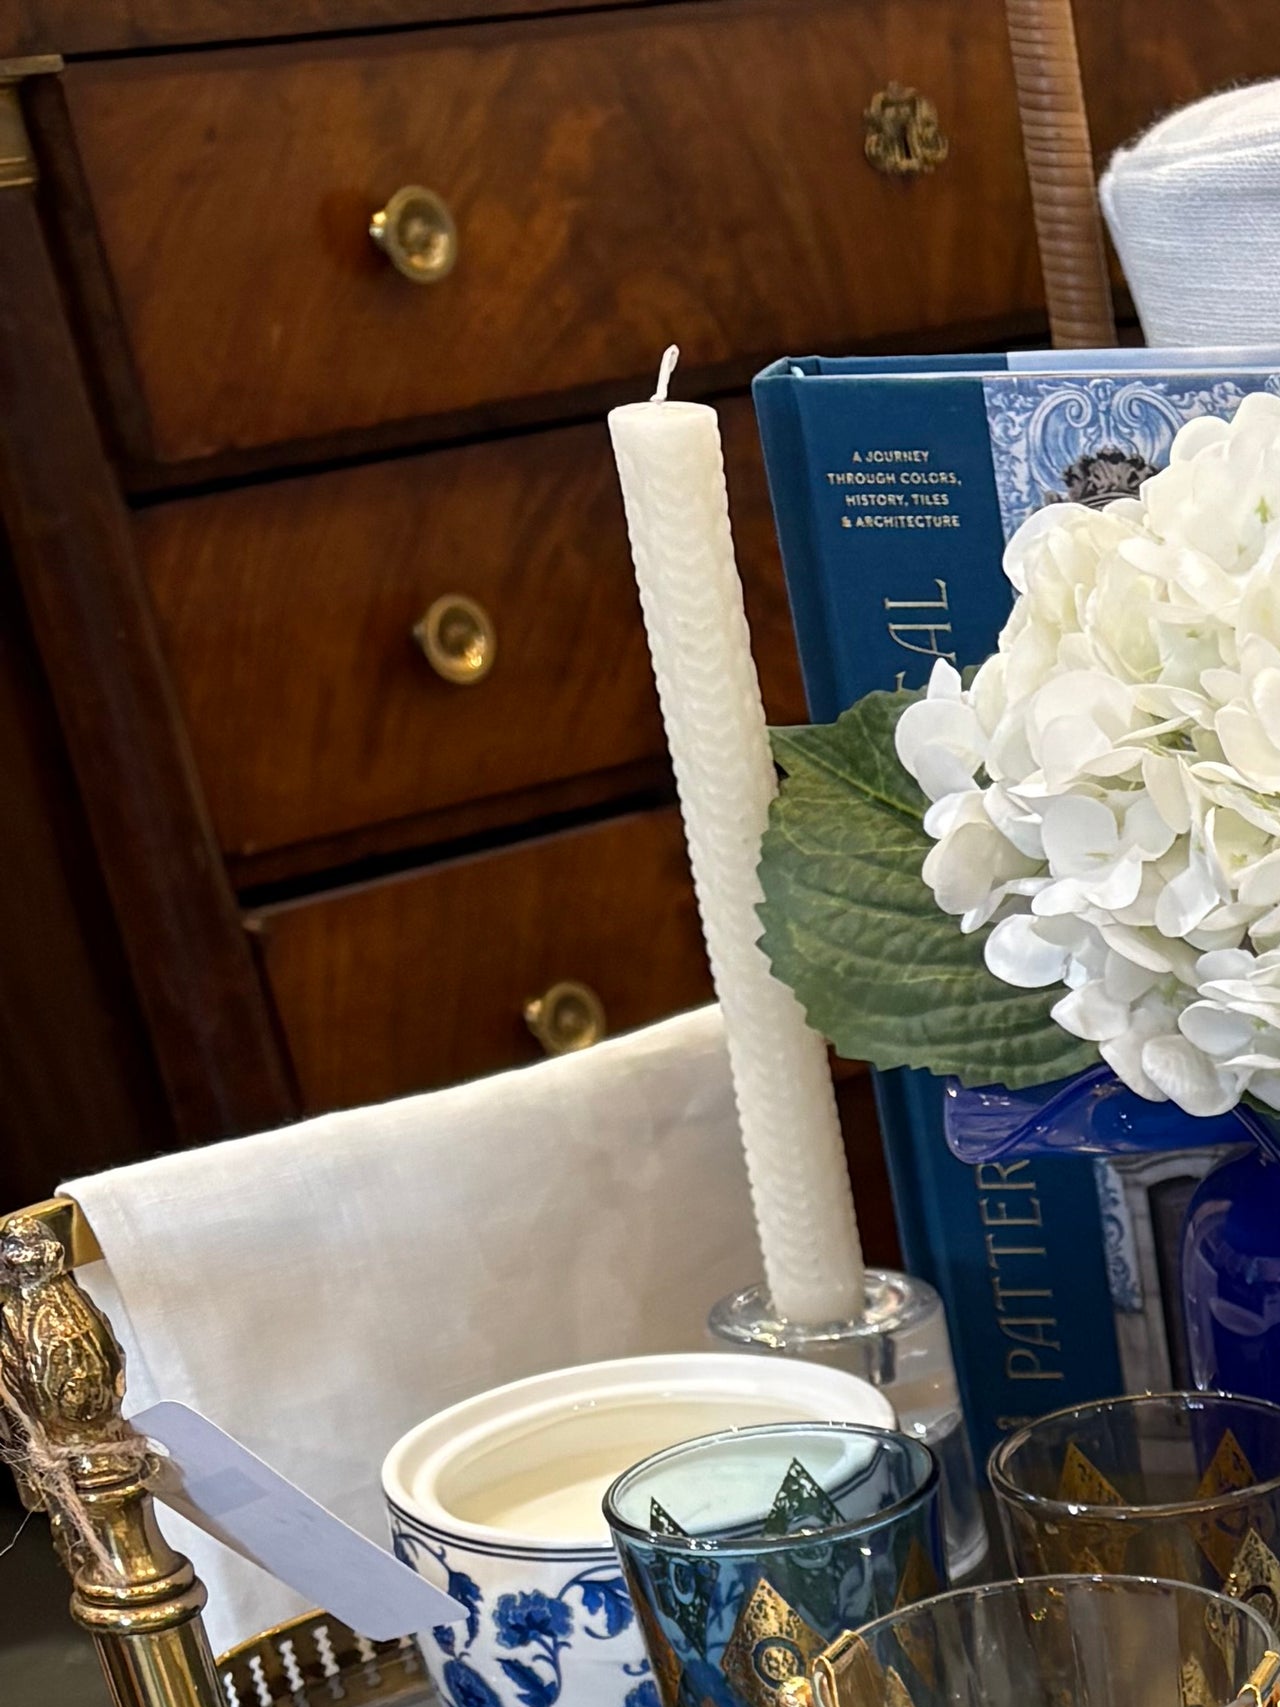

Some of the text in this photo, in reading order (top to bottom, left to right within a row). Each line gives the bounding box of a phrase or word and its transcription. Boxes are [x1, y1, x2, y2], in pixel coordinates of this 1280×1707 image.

[852, 451, 929, 463] A JOURNEY
[826, 472, 962, 486] THROUGH COLORS,
[845, 494, 949, 507] HISTORY, TILES
[841, 515, 961, 528] & ARCHITECTURE
[973, 1159, 1065, 1380] PATTER
